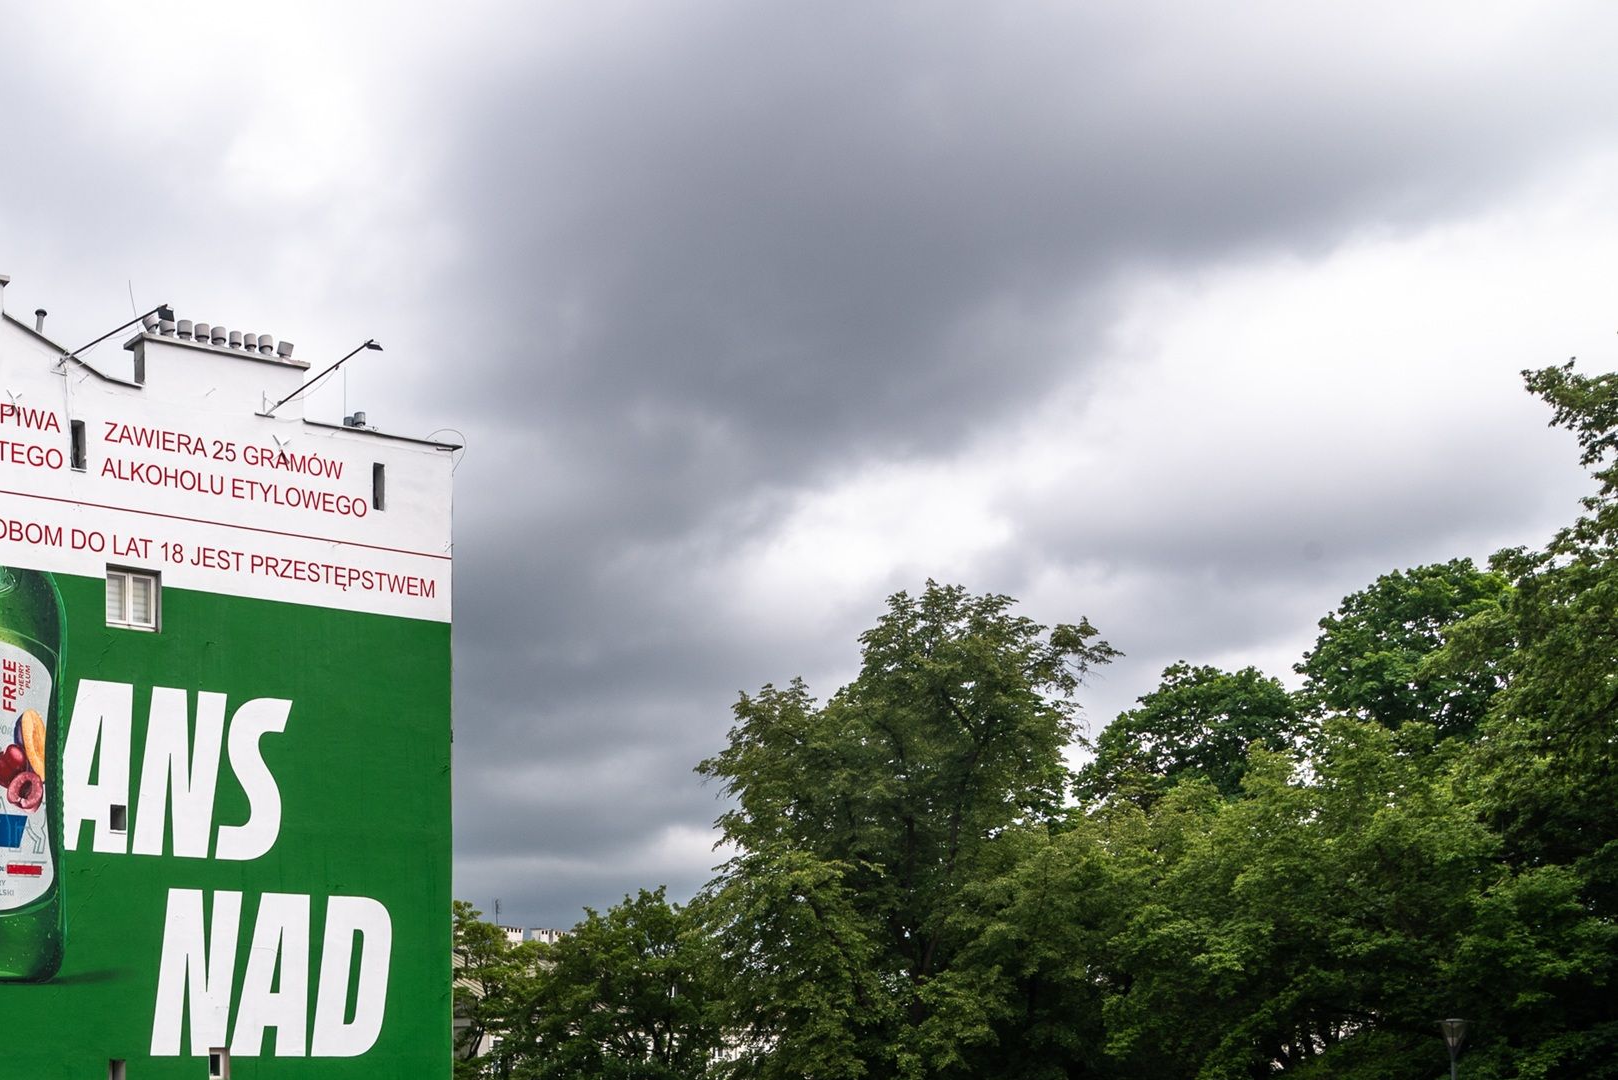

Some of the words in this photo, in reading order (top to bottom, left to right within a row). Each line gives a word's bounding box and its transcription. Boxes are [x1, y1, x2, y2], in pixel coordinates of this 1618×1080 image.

[0, 402, 61, 432] PIWA
[103, 422, 208, 458] ZAWIERA
[211, 437, 239, 463] 25
[242, 443, 343, 481] GRAMÓW
[101, 459, 224, 498] ALKOHOLU
[230, 477, 367, 517] ETYLOWEGO
[70, 528, 105, 553] DO
[112, 536, 152, 561] LAT
[159, 542, 184, 564] 18
[189, 546, 244, 571] JEST
[250, 552, 436, 599] PRZESTĘPSTWEM
[2, 658, 17, 713] FREE
[149, 889, 393, 1058] NAD
